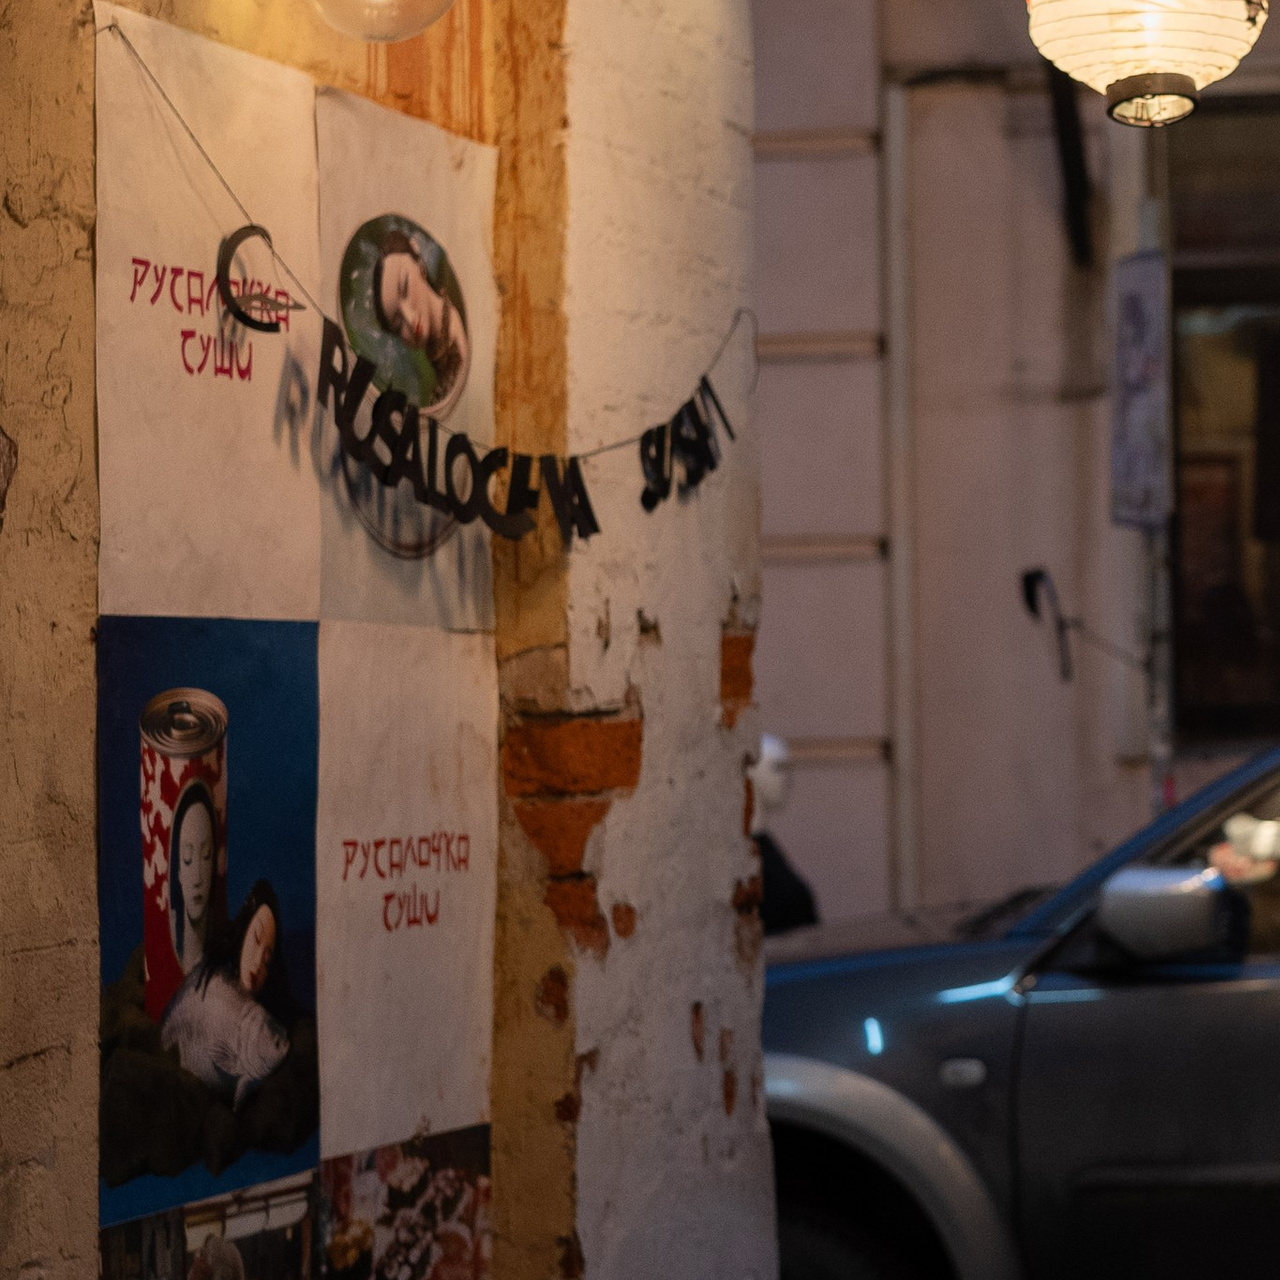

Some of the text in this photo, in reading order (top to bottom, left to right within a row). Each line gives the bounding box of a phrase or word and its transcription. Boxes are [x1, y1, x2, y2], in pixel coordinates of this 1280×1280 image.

[181, 328, 253, 382] СУШИ
[342, 831, 472, 881] РУСАЛОЧКА
[383, 881, 440, 931] СУШИ
